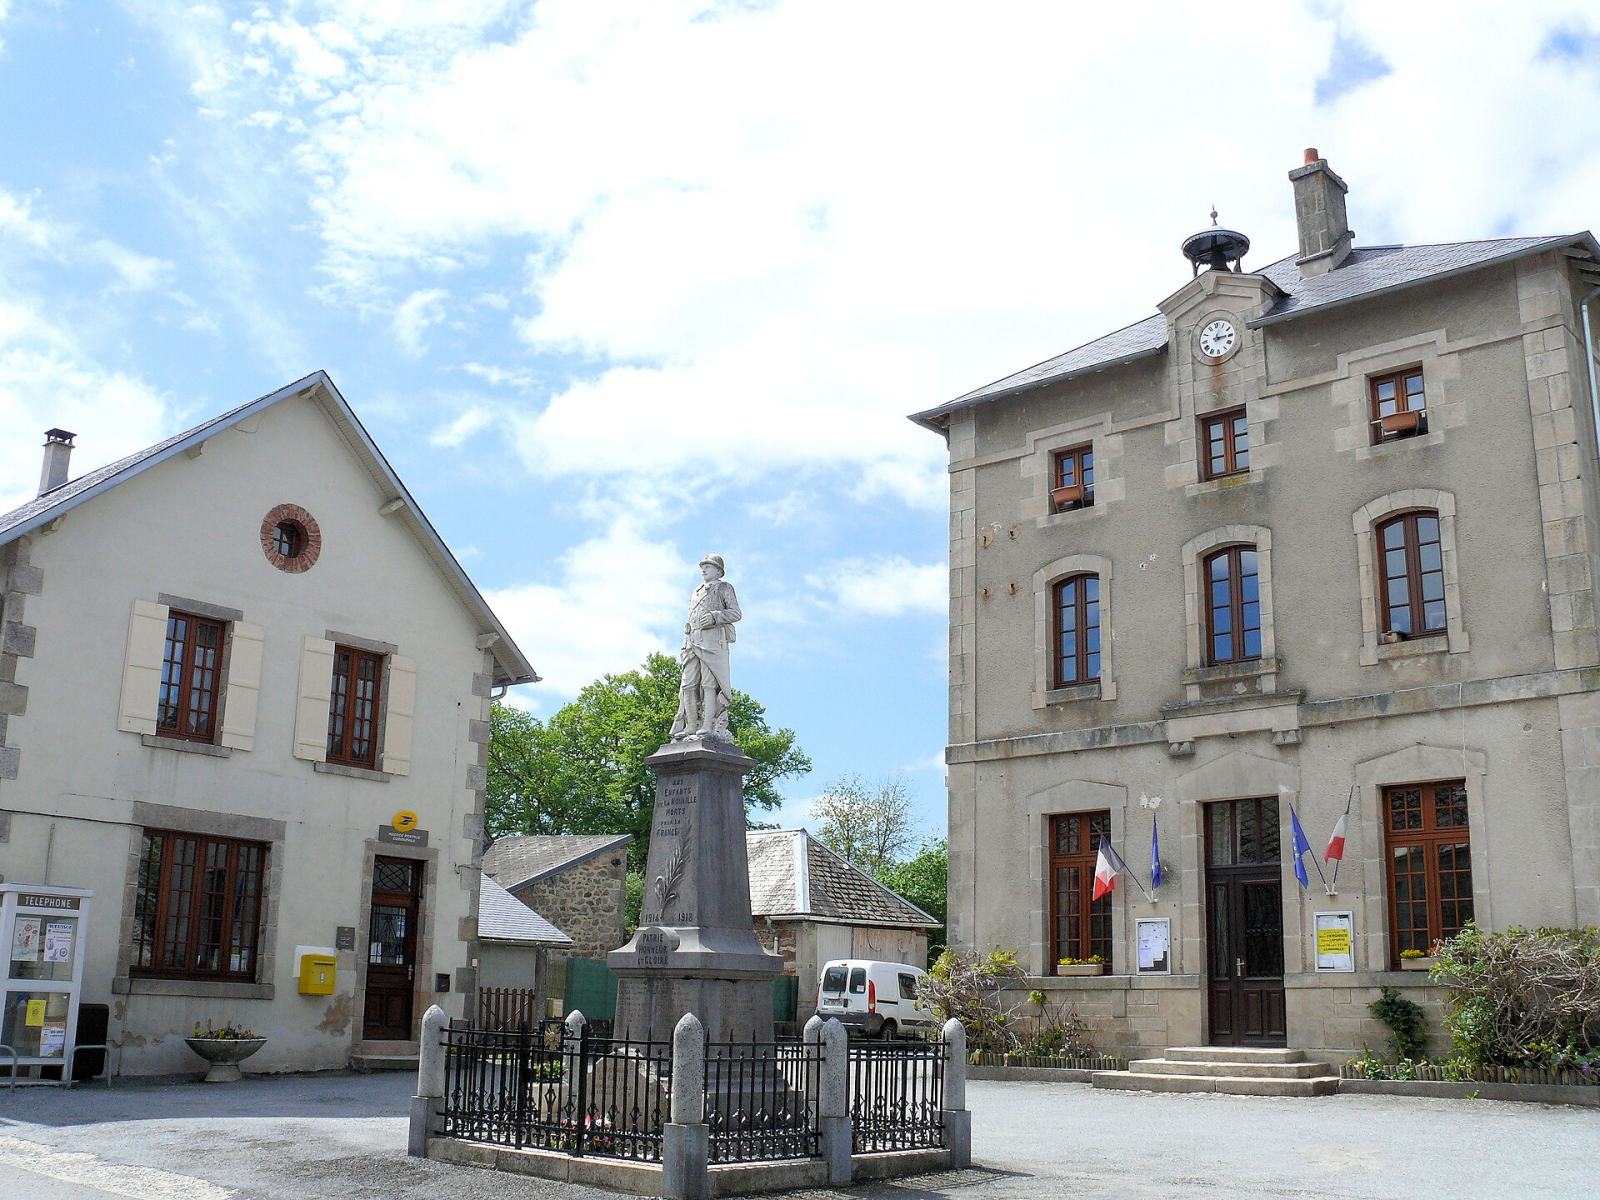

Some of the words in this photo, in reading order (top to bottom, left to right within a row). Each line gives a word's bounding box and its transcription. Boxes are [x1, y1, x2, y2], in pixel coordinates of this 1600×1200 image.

[664, 787, 692, 797] ENFANTS
[665, 807, 686, 816] MORTS
[656, 827, 678, 837] FRANCE
[25, 896, 72, 908] TELEPHONE
[678, 912, 693, 922] 1918
[642, 933, 664, 942] PATRIE
